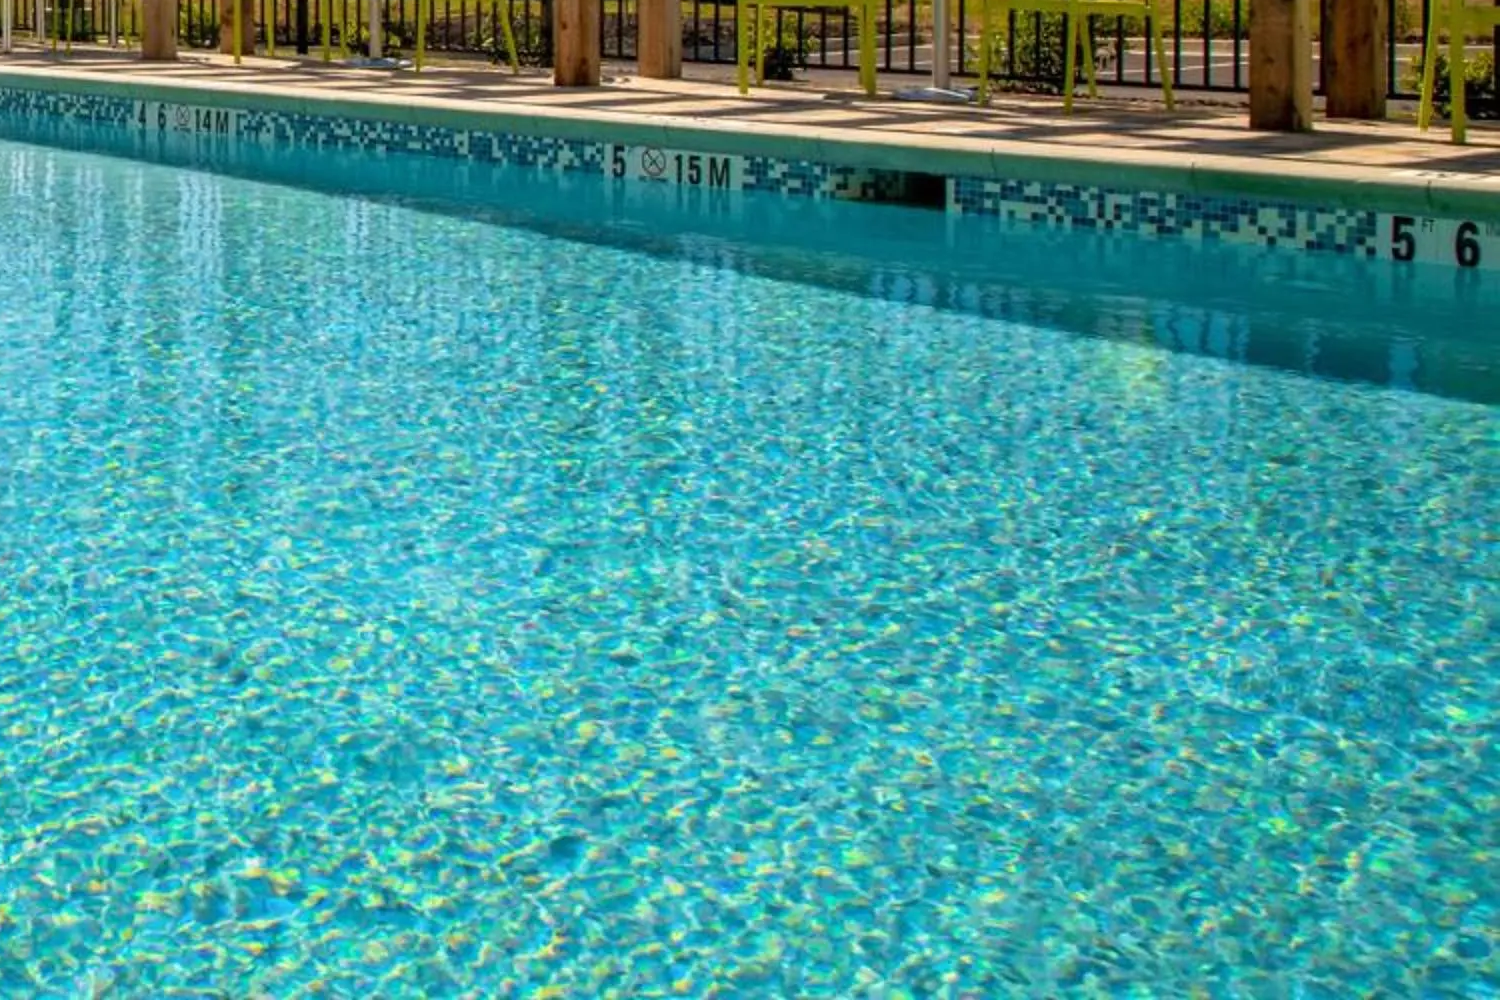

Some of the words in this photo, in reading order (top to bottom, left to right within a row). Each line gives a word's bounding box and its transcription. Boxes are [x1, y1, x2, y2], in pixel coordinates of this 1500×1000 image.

[138, 102, 146, 127] 4
[158, 103, 166, 129] 6
[612, 145, 626, 178] 5
[1392, 216, 1415, 260] 5
[1456, 221, 1480, 267] 6
